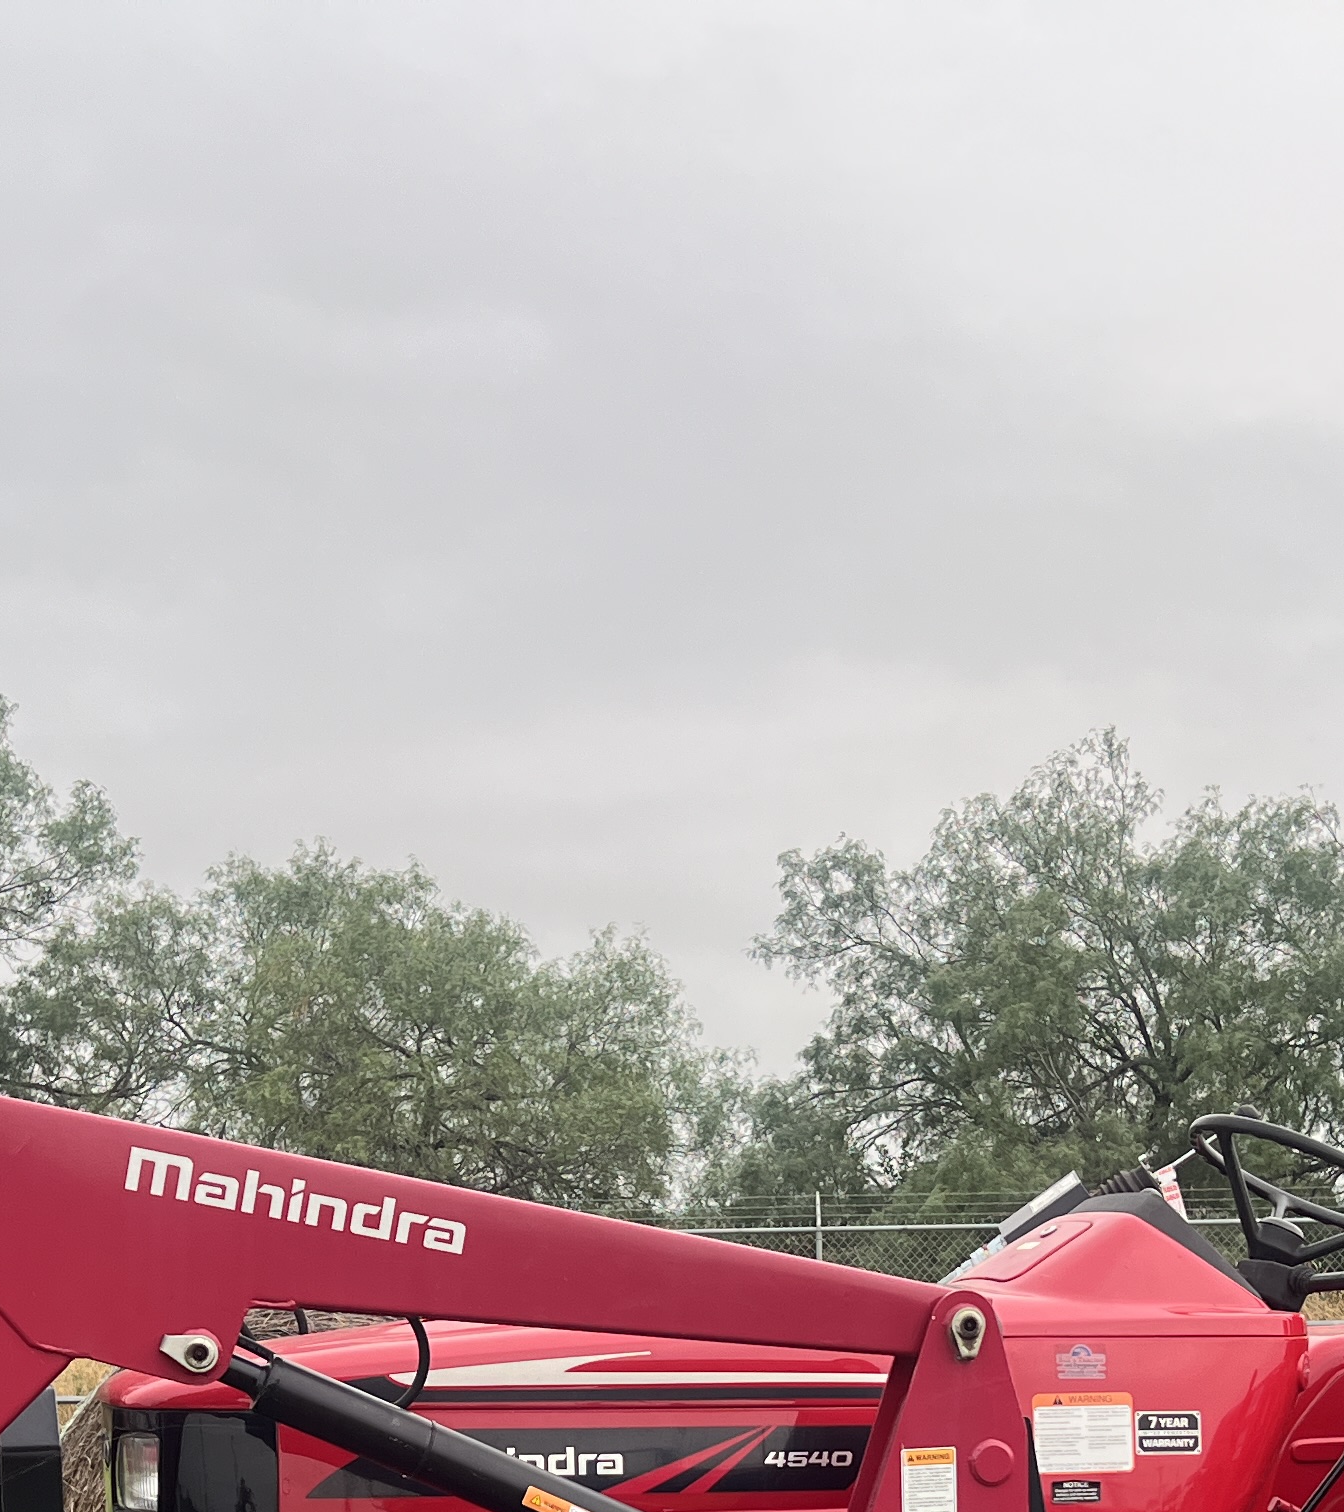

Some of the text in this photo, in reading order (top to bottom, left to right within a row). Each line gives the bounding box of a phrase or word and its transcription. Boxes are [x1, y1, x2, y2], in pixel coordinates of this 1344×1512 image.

[124, 1146, 466, 1255] Mahindra
[1068, 1394, 1112, 1404] WARNING
[1147, 1415, 1189, 1429] 7 YEAR
[1142, 1438, 1195, 1448] WARRANTY
[764, 1450, 853, 1468] 4540
[916, 1452, 950, 1461] WARNING
